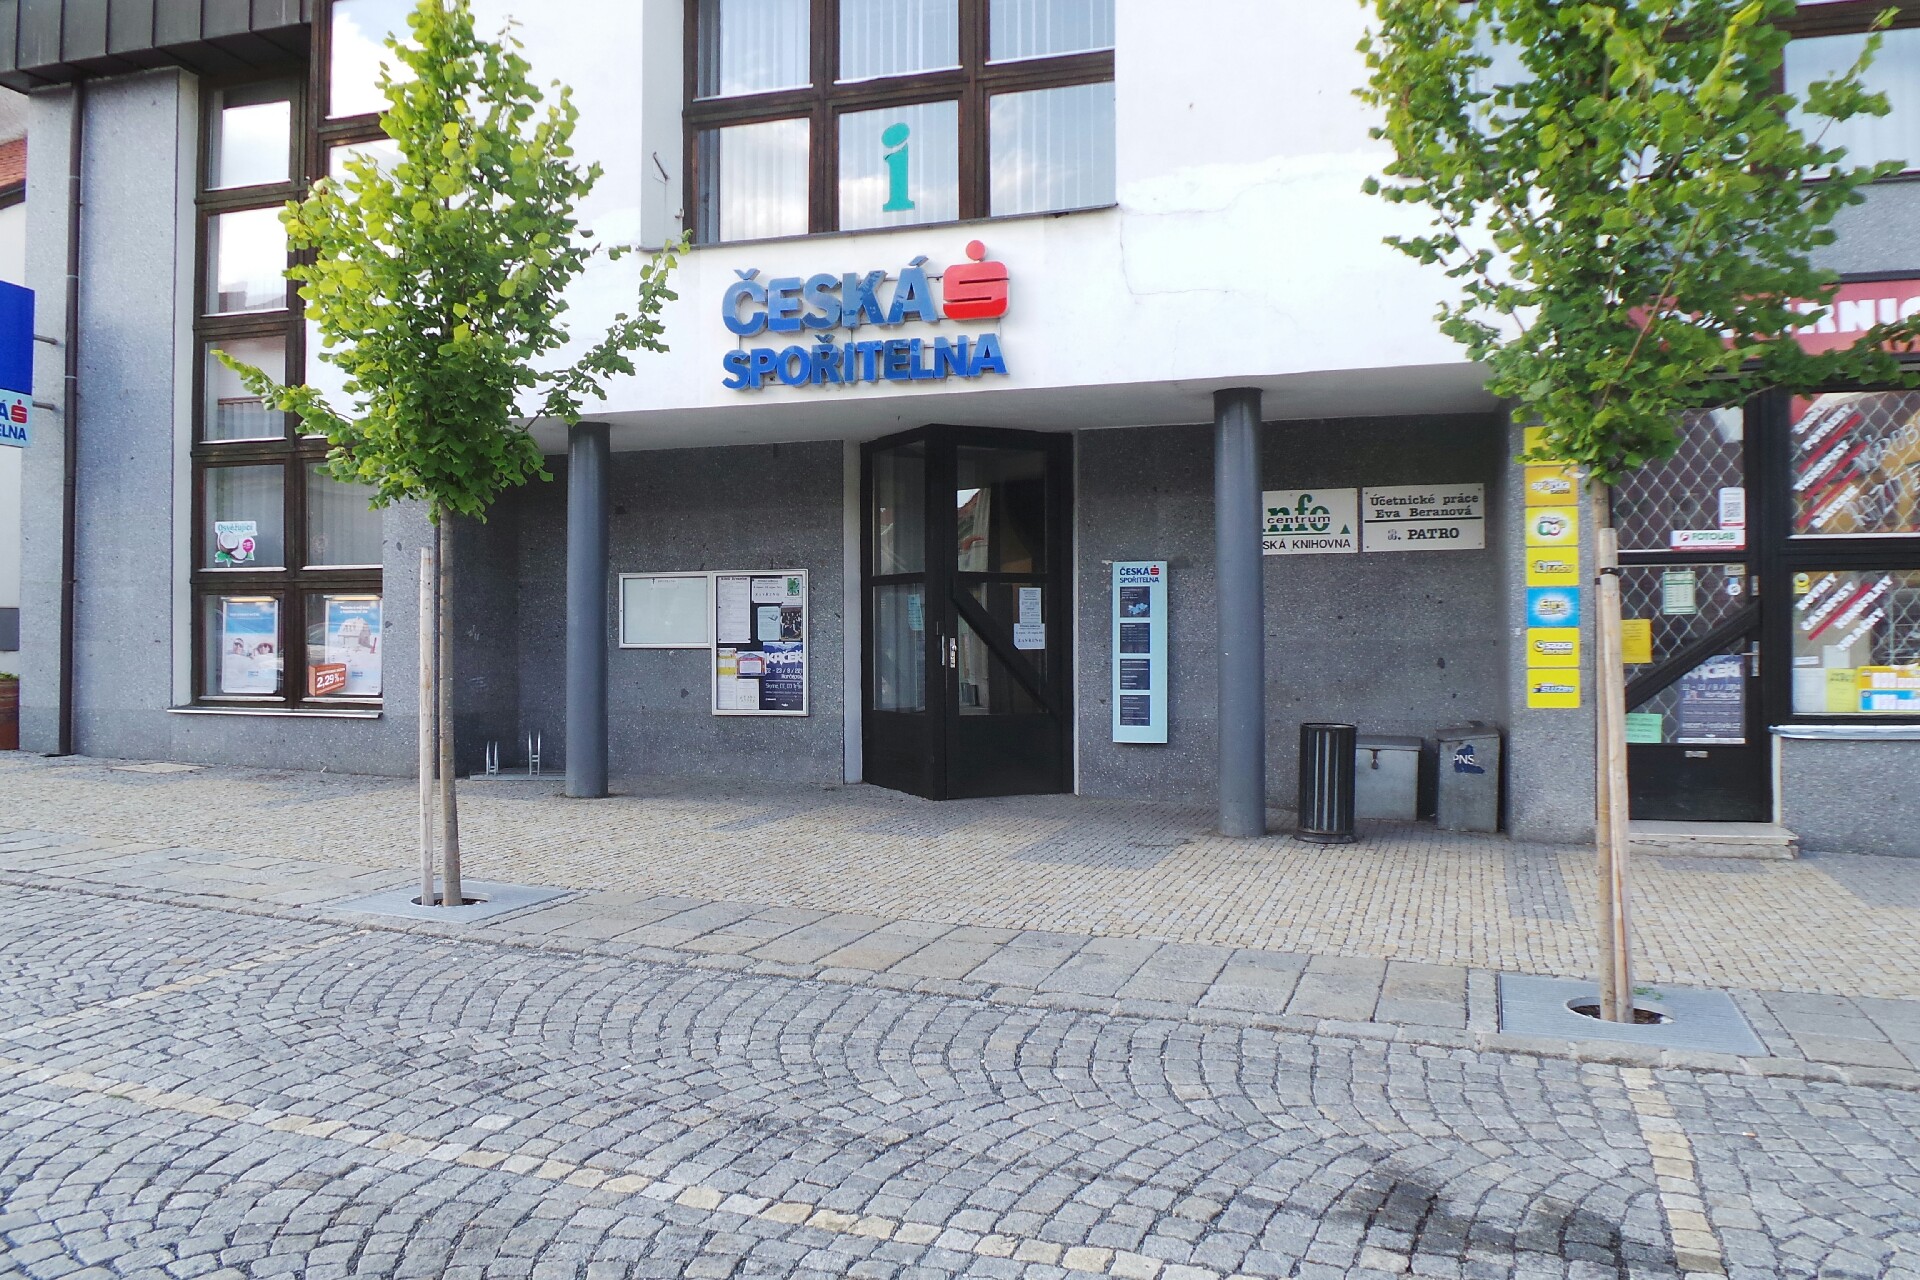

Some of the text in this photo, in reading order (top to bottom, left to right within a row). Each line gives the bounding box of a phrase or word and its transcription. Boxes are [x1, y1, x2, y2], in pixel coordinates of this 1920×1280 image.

[722, 255, 938, 336] ČESKÁ
[722, 334, 1008, 389] SPOŘITELNA
[1370, 493, 1479, 506] Účetnické práce
[1263, 494, 1330, 532] nfo
[1375, 505, 1472, 518] Eva Beranová
[1267, 516, 1330, 524] centrum
[1407, 528, 1459, 539] PATRO
[1692, 532, 1735, 540] FOTOLAB
[1293, 539, 1351, 549] KNIHOVNA
[1120, 566, 1150, 575] ČESKÁ
[1795, 573, 1837, 610] NOVINY
[1800, 581, 1855, 630] ČASOPISY
[1453, 755, 1474, 764] PNS
